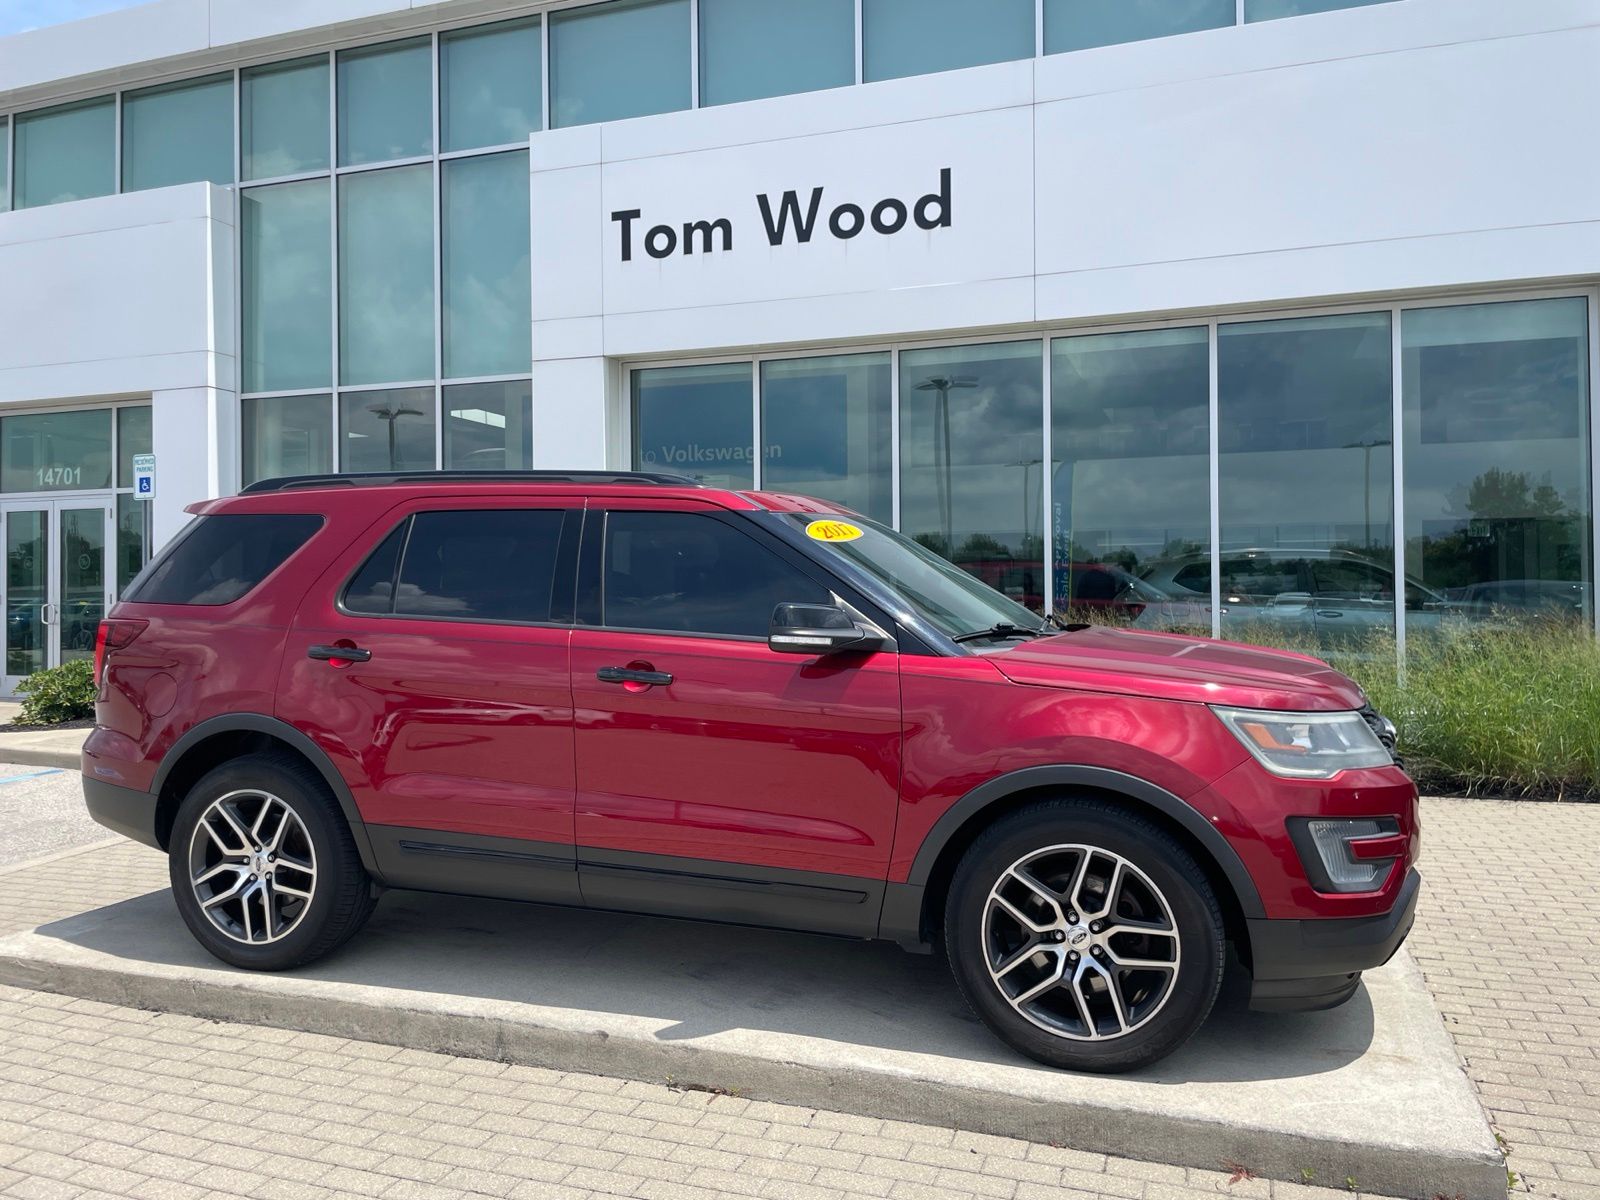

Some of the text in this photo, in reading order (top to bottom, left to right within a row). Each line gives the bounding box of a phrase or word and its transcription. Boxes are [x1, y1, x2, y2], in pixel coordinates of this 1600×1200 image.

[611, 167, 952, 262] Tom Wood
[36, 466, 81, 486] 14701
[816, 523, 854, 539] 2017
